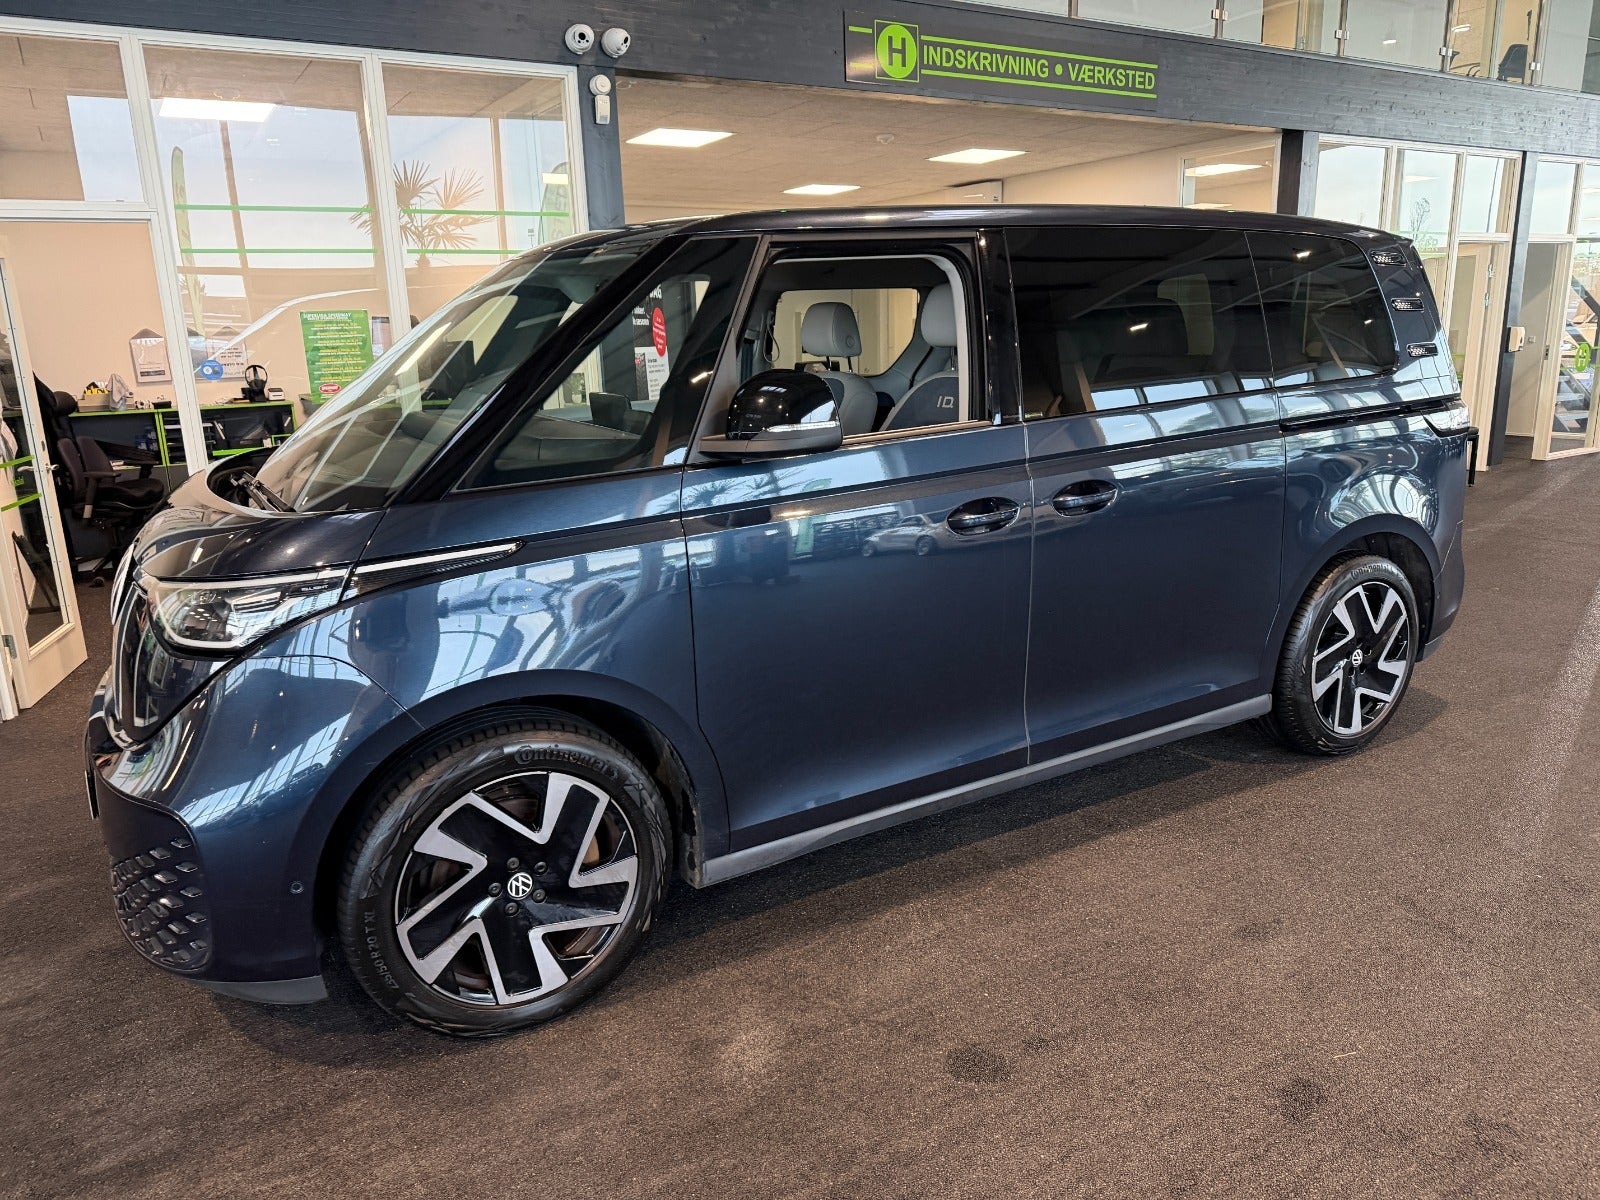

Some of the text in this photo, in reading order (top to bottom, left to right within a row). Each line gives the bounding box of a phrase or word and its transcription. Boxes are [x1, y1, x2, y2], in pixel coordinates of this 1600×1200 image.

[887, 35, 907, 68] H
[923, 44, 1156, 90] INDSKRIVNING VÆRKSTED
[514, 744, 609, 775] Continental
